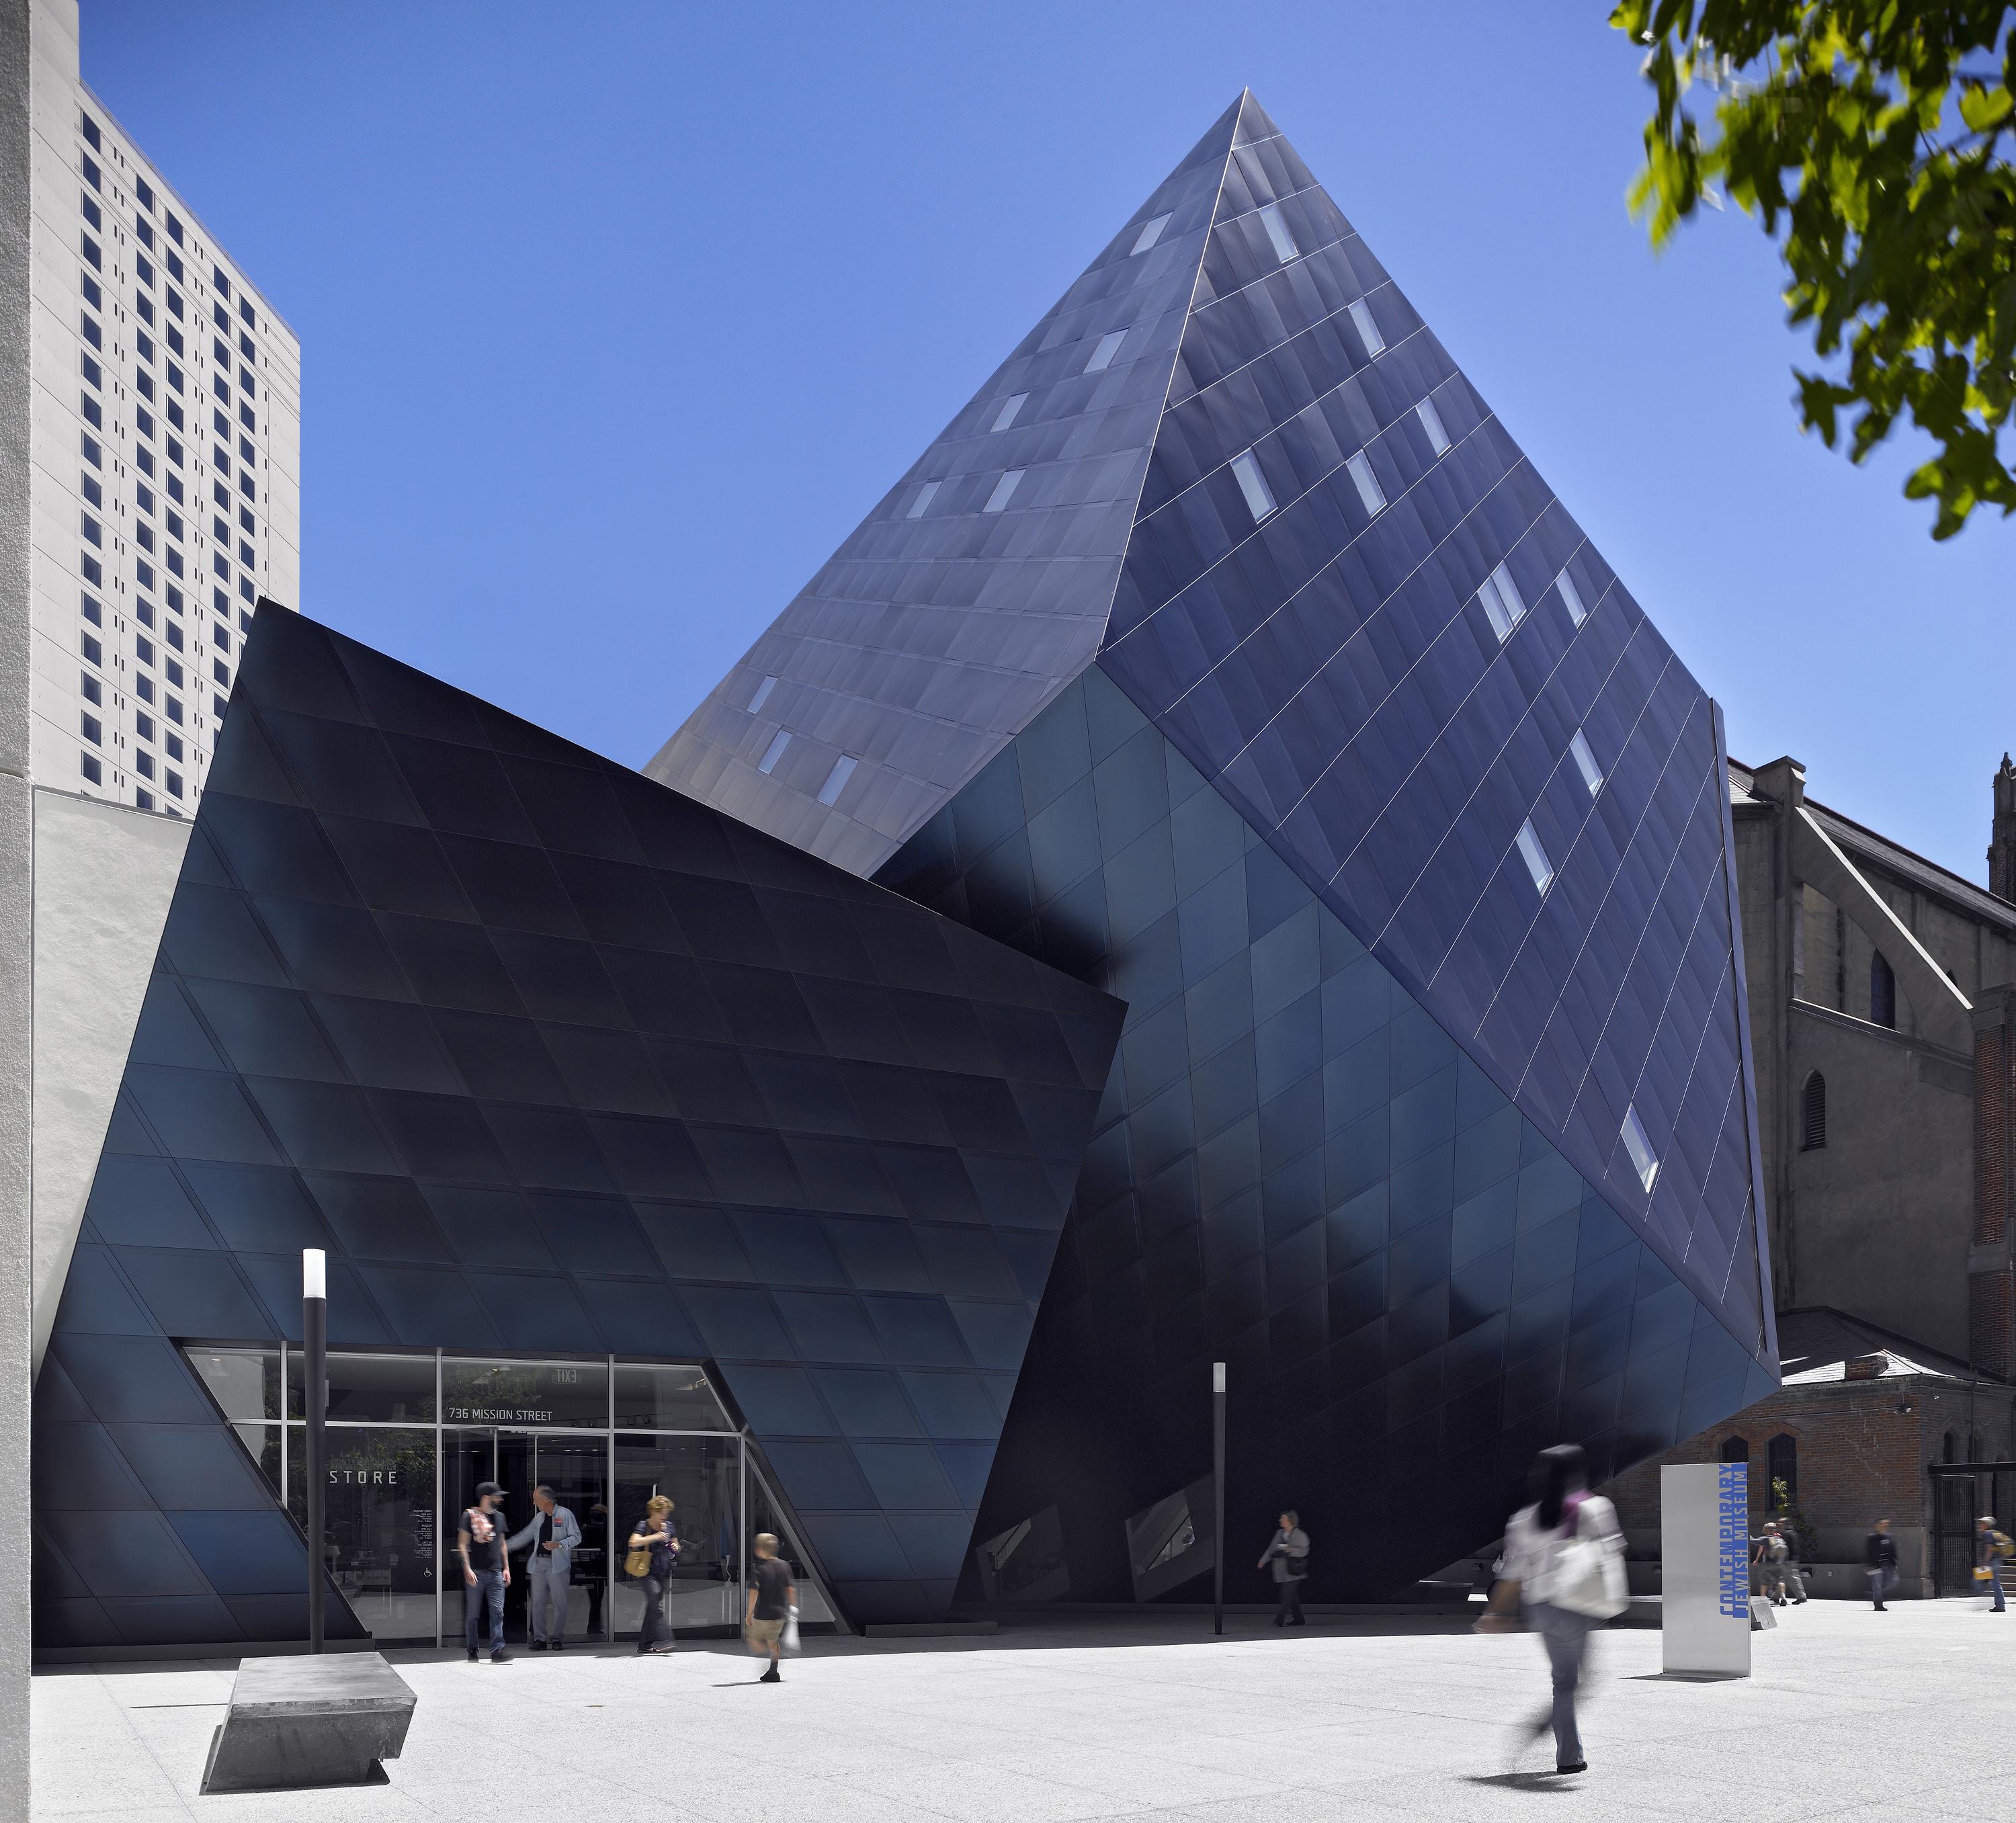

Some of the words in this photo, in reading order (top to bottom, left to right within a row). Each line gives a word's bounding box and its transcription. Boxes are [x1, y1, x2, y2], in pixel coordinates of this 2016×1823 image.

[449, 1408, 468, 1418] 736
[472, 1408, 513, 1420] MISSION
[516, 1410, 553, 1421] STREET
[329, 1470, 397, 1484] STORE
[1734, 1471, 1748, 1540] MUSEUM
[1719, 1464, 1734, 1615] CONTEMPORARY
[1734, 1550, 1748, 1611] JEWISH
